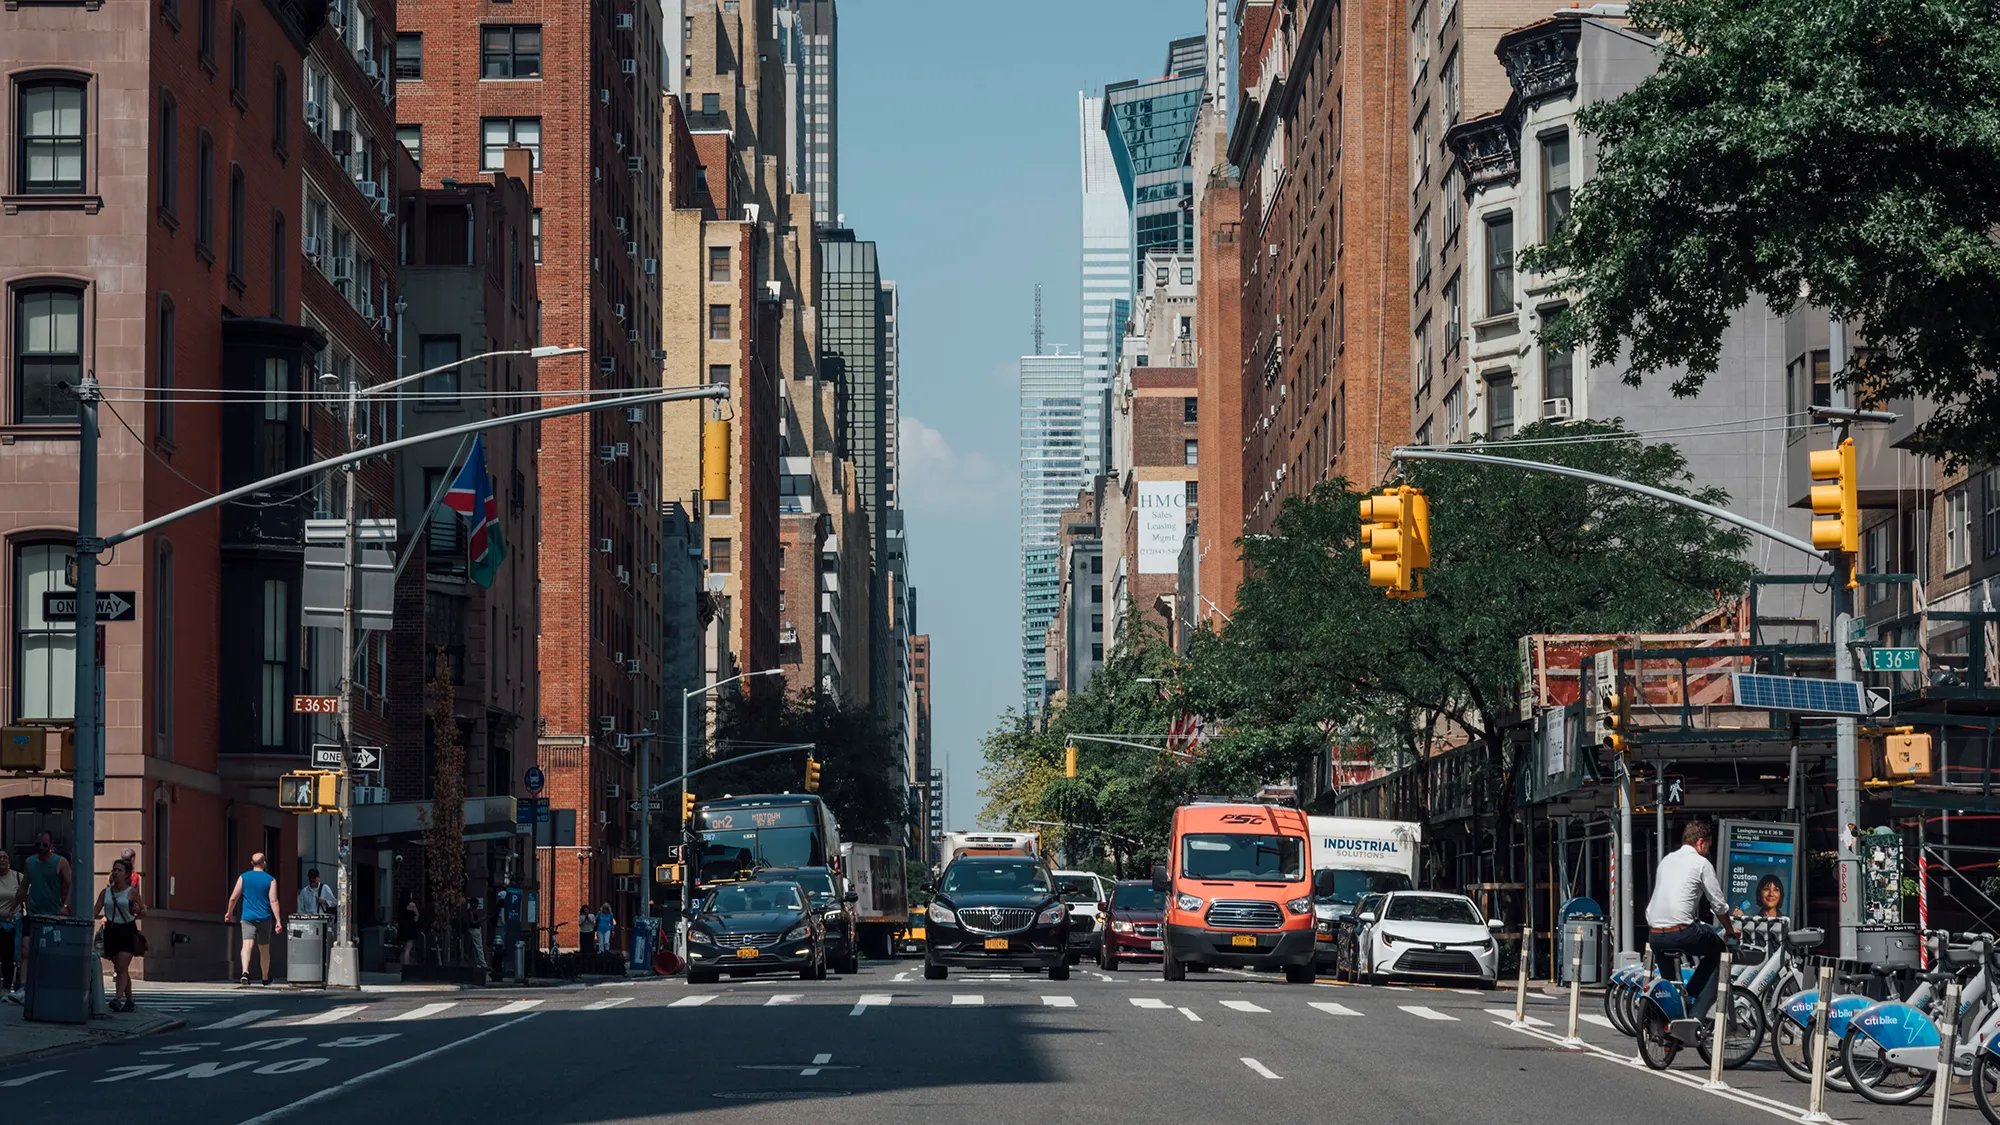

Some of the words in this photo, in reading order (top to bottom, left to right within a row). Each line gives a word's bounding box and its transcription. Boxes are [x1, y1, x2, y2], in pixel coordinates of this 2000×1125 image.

[1140, 494, 1186, 508] HMC
[1152, 511, 1173, 519] Sales
[1147, 522, 1177, 531] Leasing
[56, 601, 77, 613] ON
[1873, 651, 1880, 668] E
[1886, 651, 1902, 668] 36
[1904, 651, 1916, 660] ST
[295, 698, 302, 711] E
[305, 698, 320, 712] 36
[323, 699, 337, 712] ST
[1324, 838, 1398, 852] INDUSTRIAL
[1336, 851, 1385, 859] SOLUTIONS
[1791, 1002, 1805, 1012] citi
[1864, 1015, 1879, 1025] citi
[1879, 1015, 1898, 1025] bike
